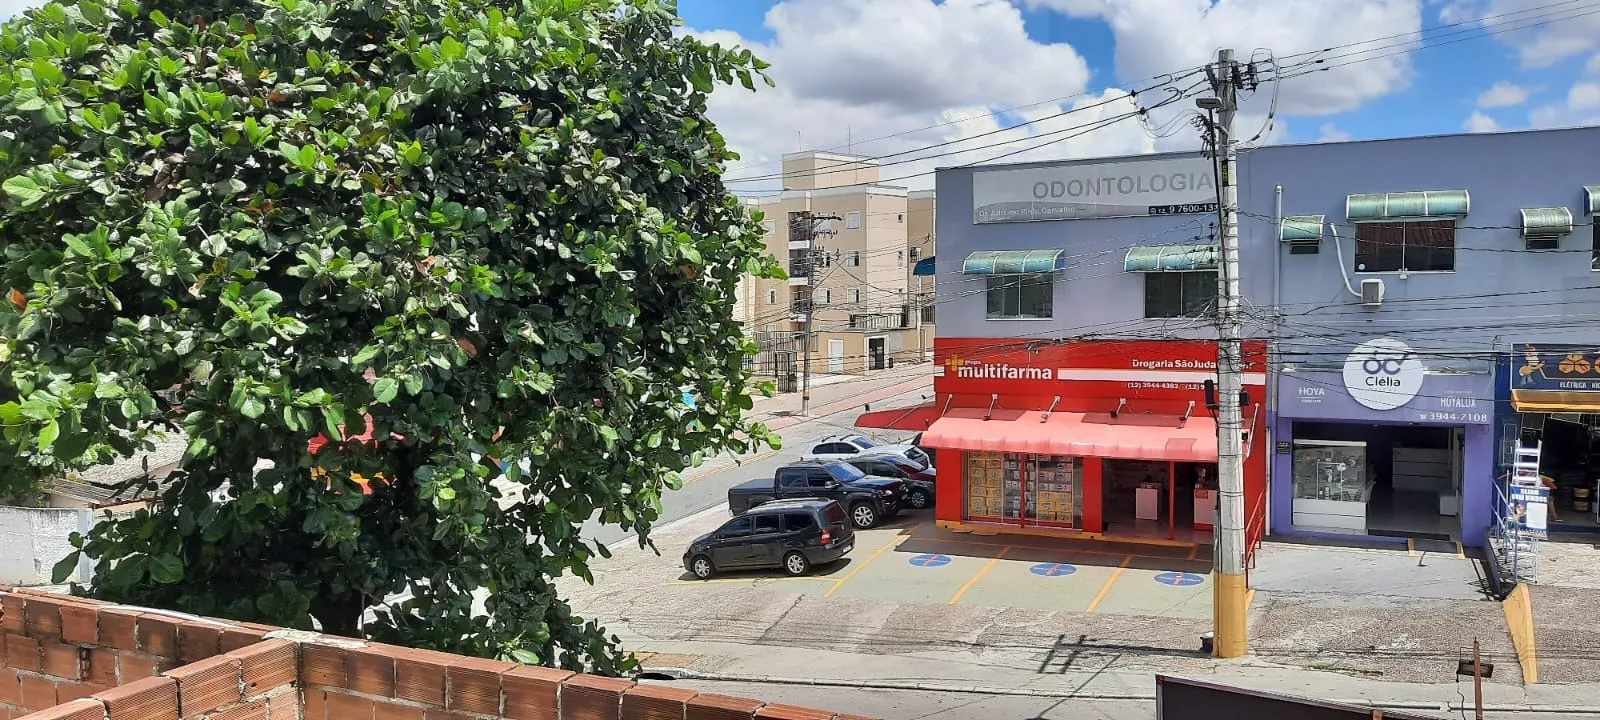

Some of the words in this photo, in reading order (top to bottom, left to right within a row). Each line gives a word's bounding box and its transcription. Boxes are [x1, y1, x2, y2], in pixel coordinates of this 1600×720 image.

[1032, 172, 1214, 199] ODONTOLOGIA
[1132, 359, 1173, 369] Drogaria
[1193, 360, 1217, 369] Juda
[958, 364, 1052, 380] multifarma
[1365, 376, 1401, 387] Clélia
[1298, 387, 1325, 396] HOYA
[1429, 412, 1488, 422] 3944-7108
